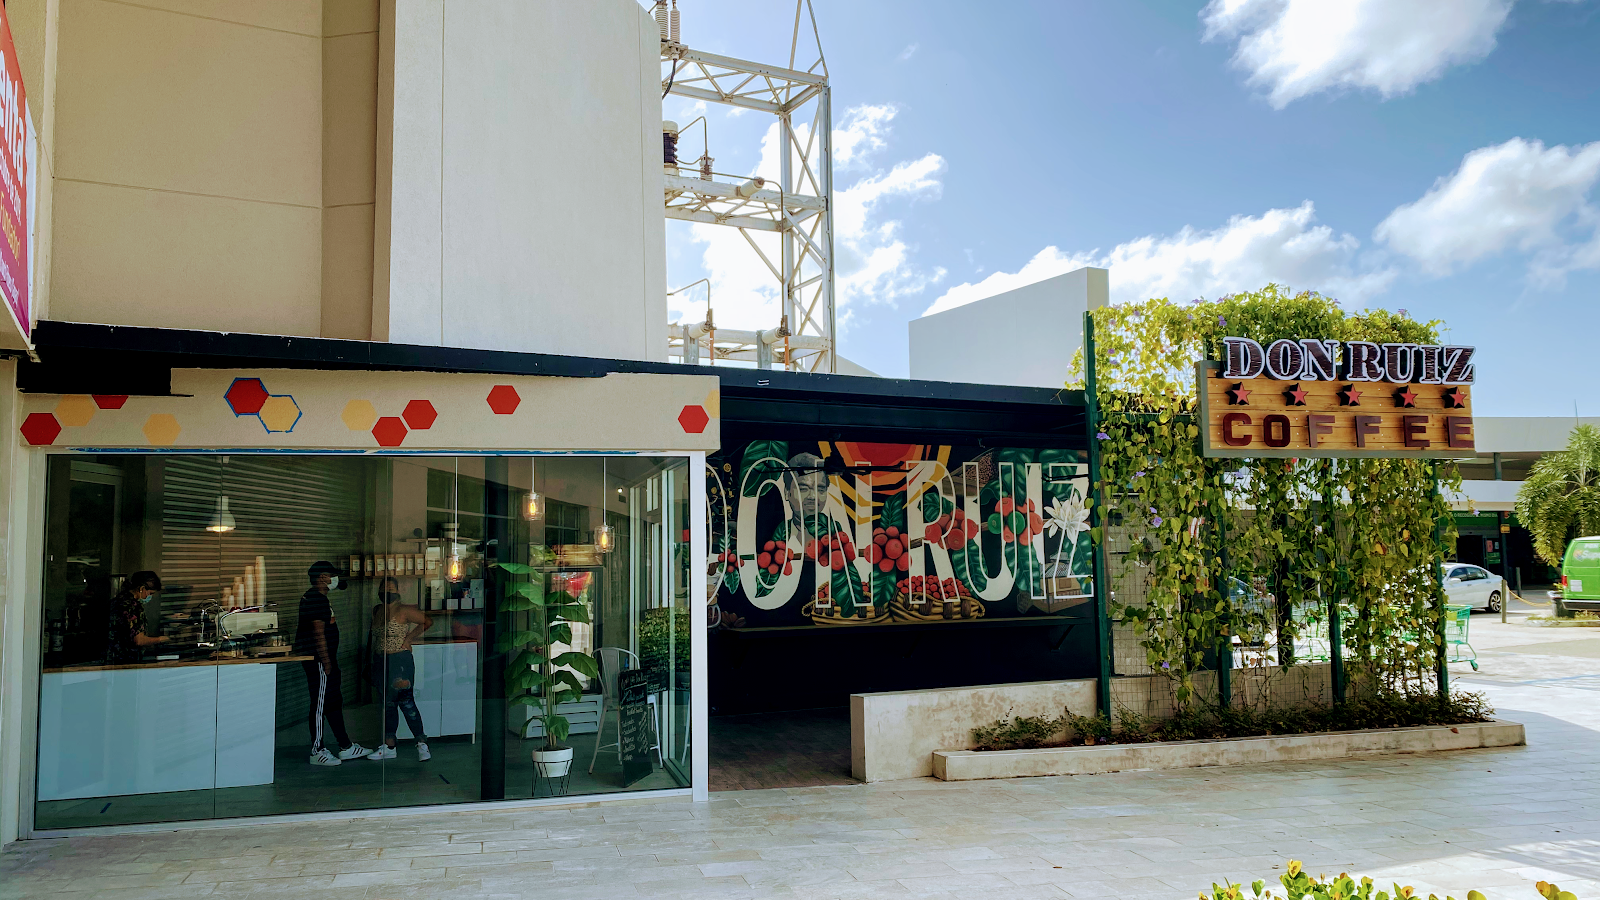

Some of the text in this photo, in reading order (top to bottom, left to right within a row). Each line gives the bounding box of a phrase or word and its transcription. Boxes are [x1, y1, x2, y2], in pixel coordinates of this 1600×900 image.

[1223, 336, 1477, 386] DON RUIZ
[1222, 412, 1475, 449] COFFEE
[906, 460, 1095, 605] RUIZ
